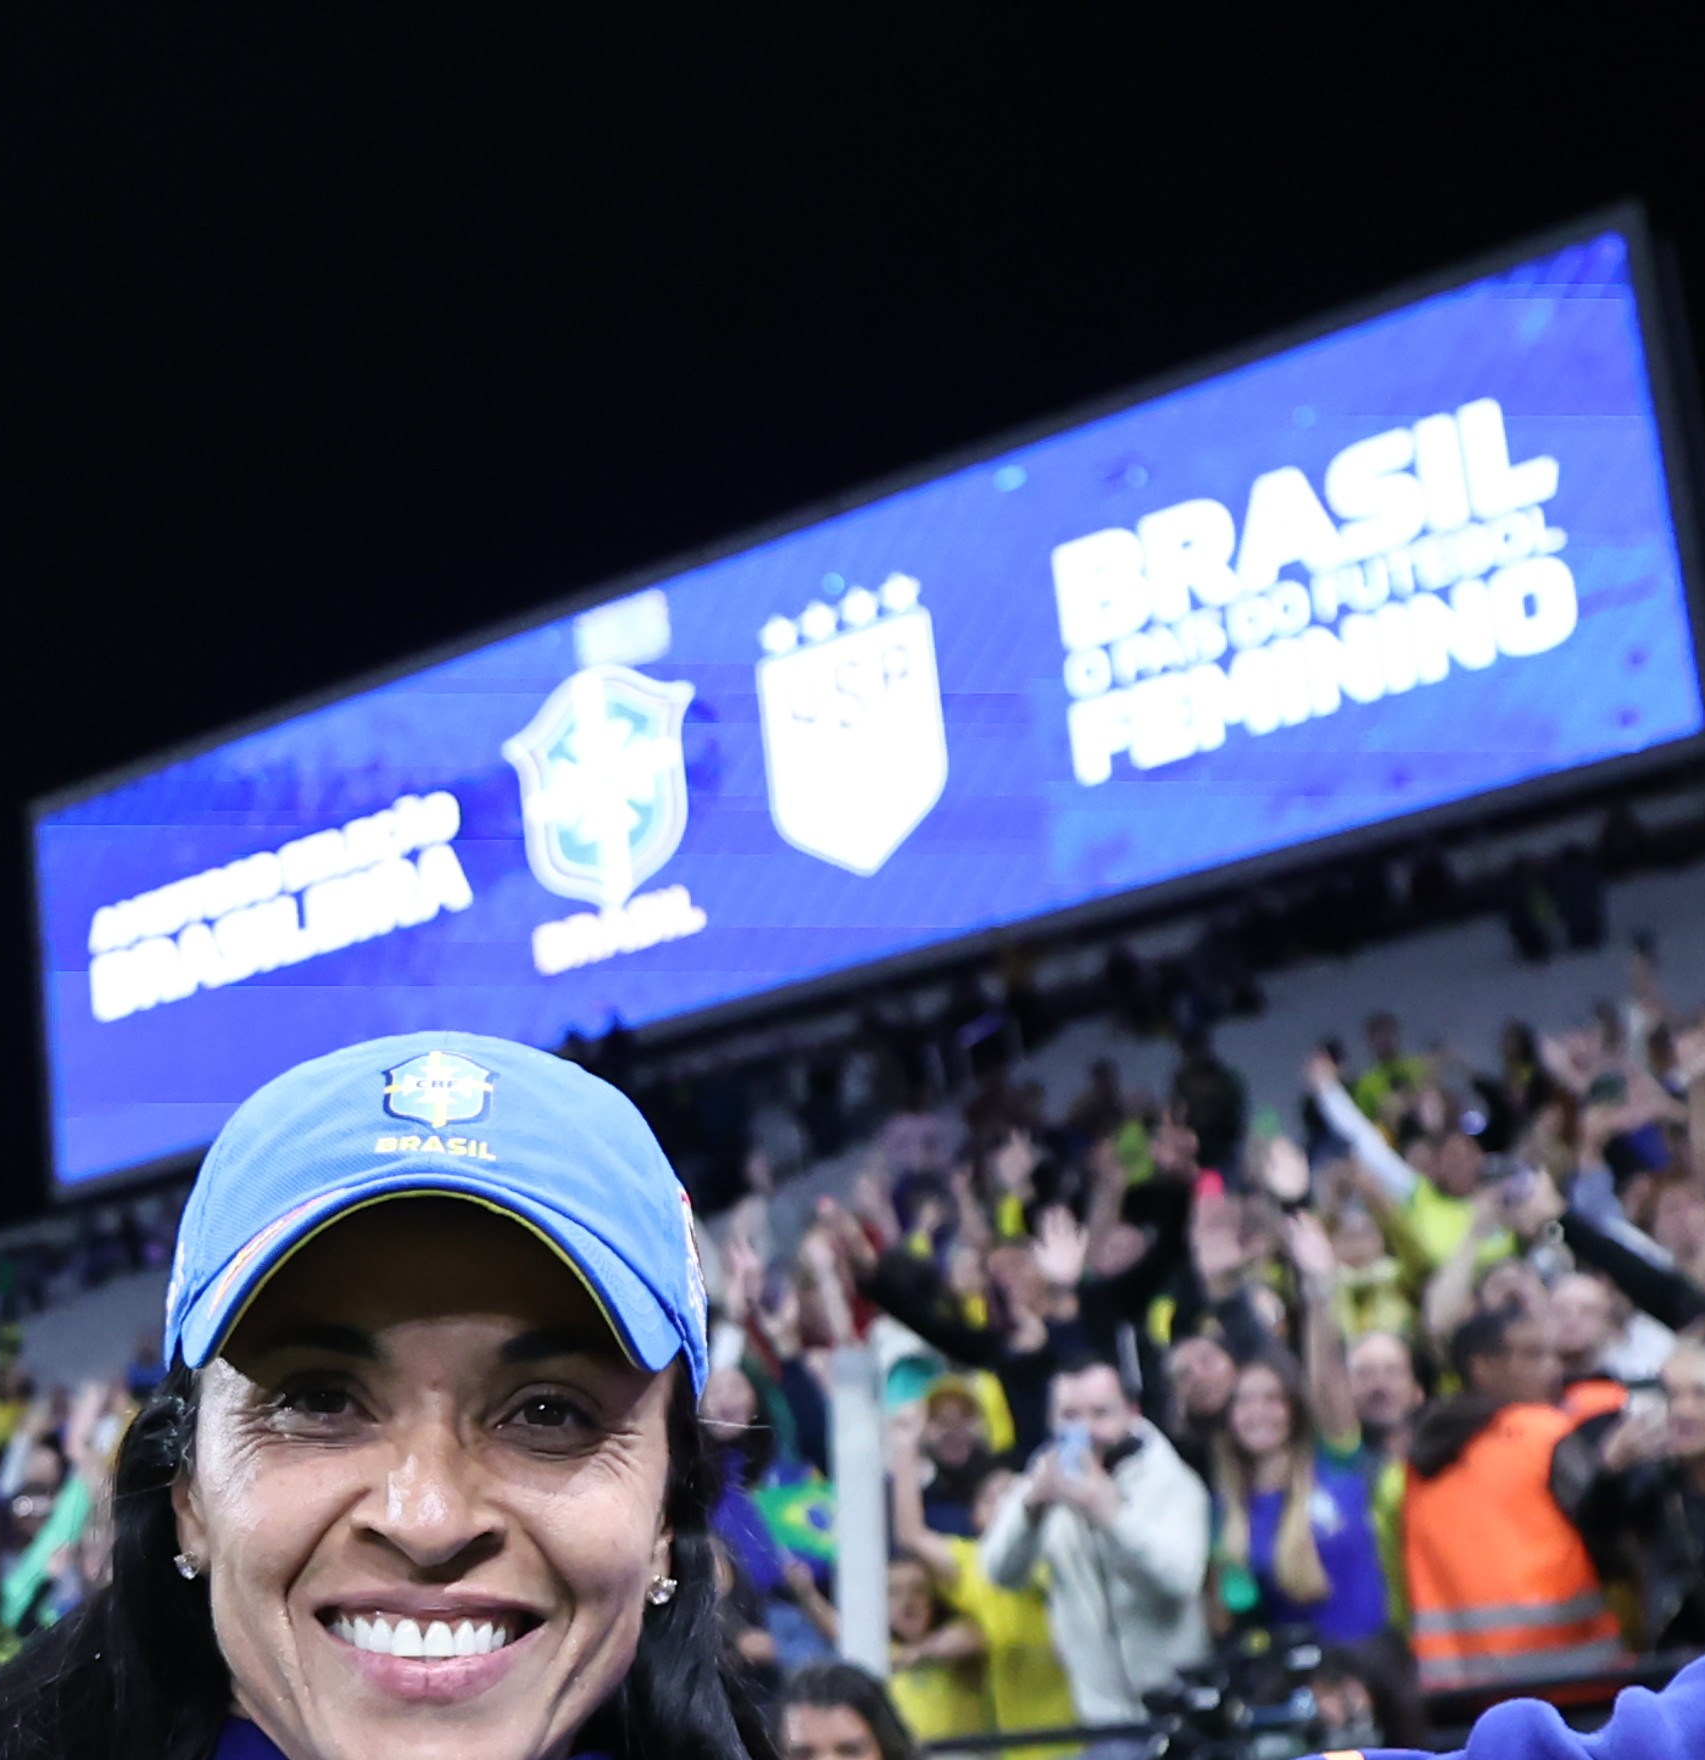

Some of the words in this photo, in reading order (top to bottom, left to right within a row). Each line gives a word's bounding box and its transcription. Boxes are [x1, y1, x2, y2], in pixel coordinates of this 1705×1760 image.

[1054, 398, 1558, 648] BRASIL
[1066, 645, 1112, 697] O
[1314, 506, 1566, 622] FUTEBOL
[1071, 556, 1577, 786] FEMININO
[374, 1135, 497, 1162] BRASIL
[415, 1079, 457, 1089] CBF
